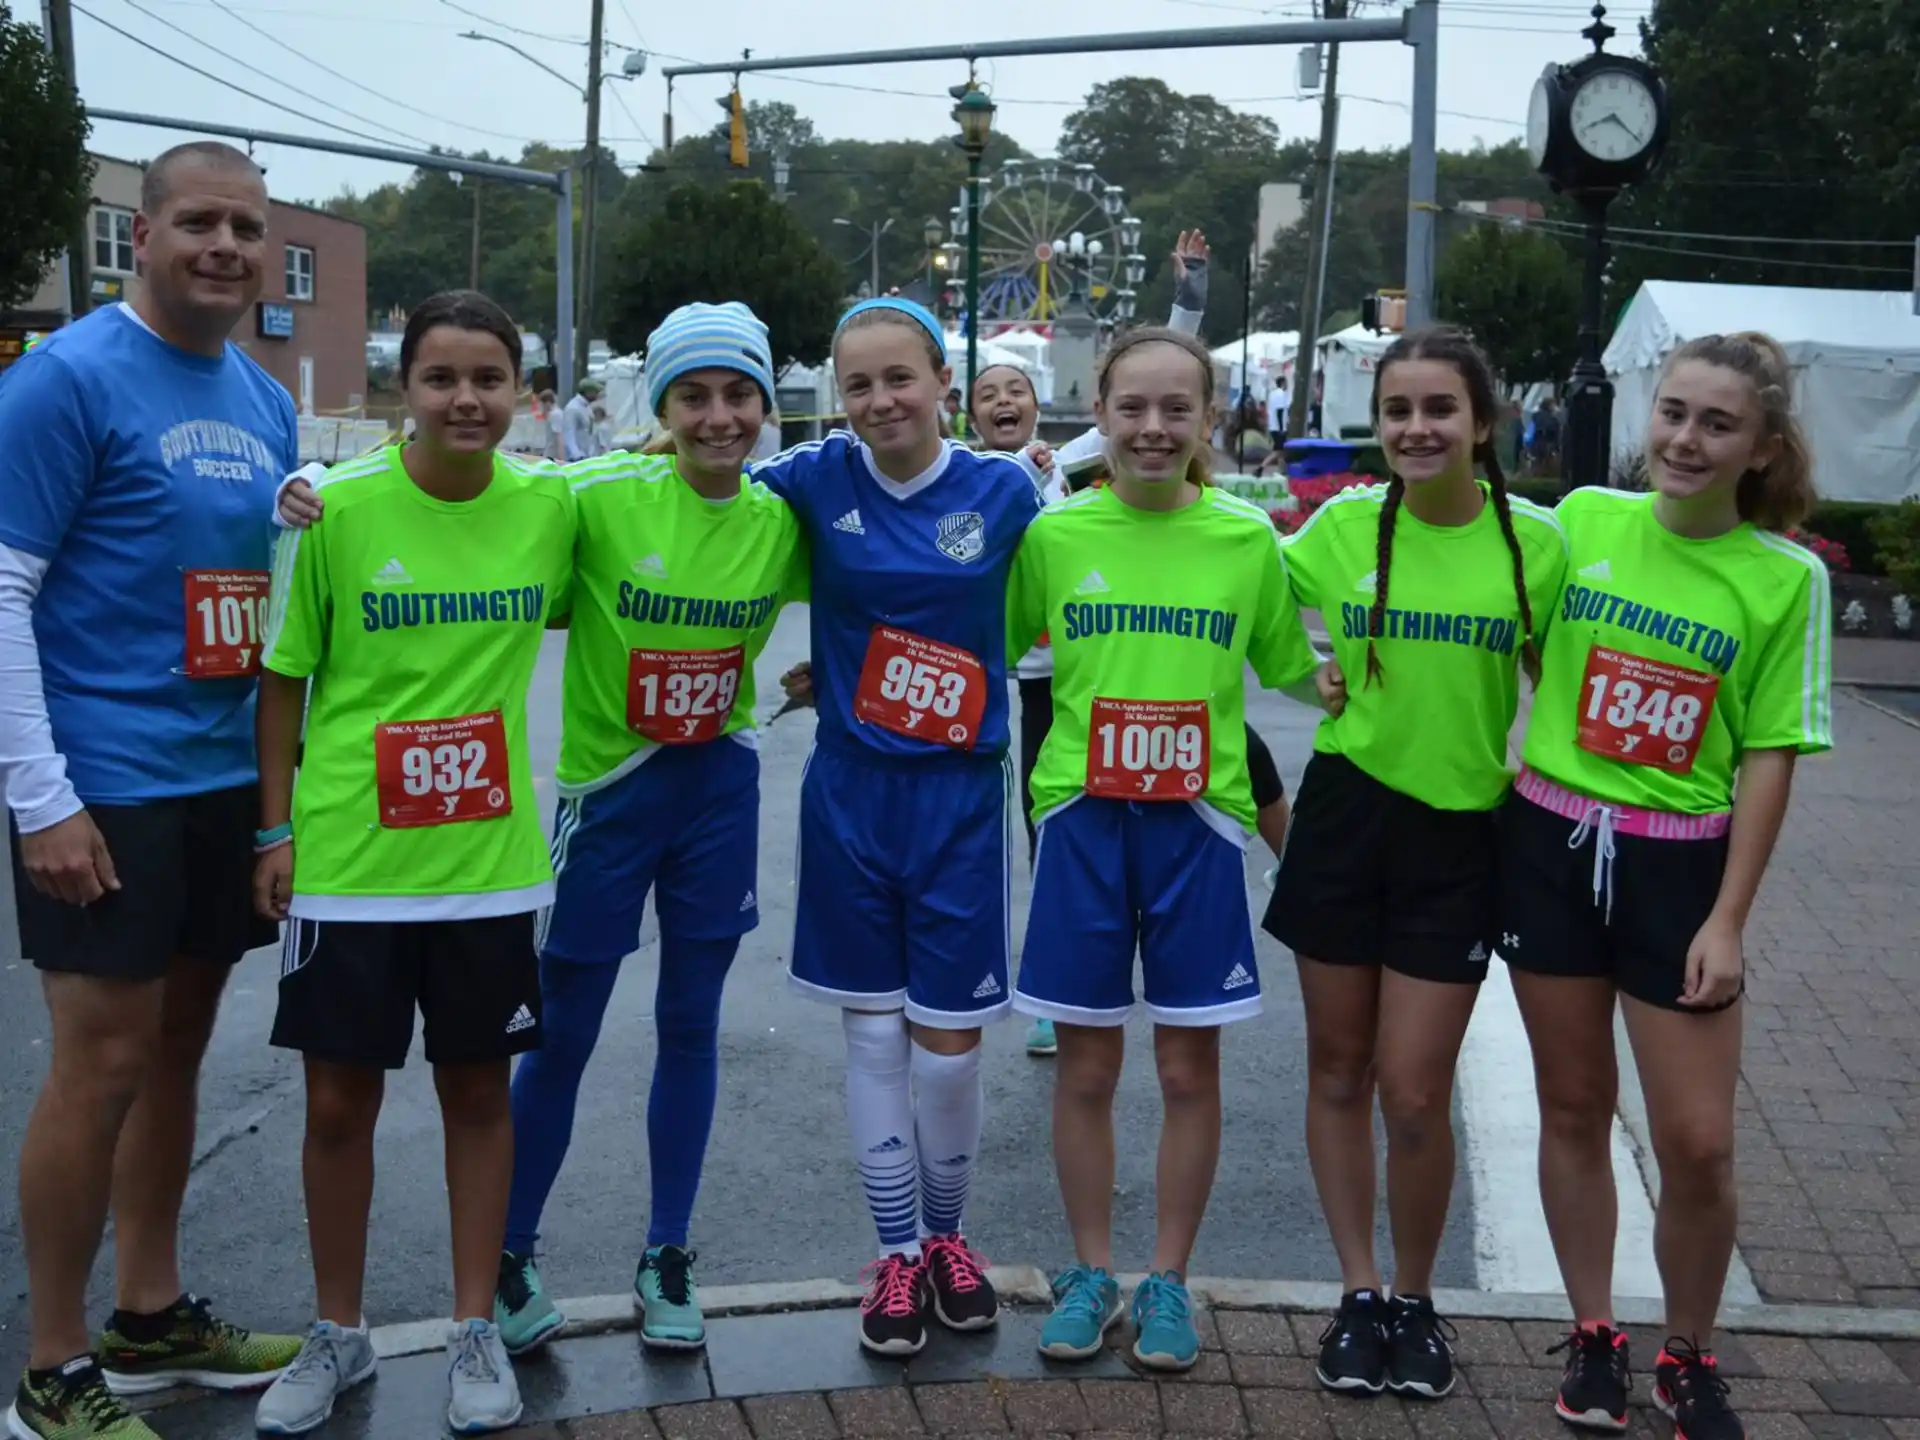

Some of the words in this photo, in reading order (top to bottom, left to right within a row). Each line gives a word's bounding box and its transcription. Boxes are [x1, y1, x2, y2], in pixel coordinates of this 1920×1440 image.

[192, 458, 253, 481] SOCCER
[360, 583, 545, 632] SOUTHINGTON
[616, 579, 778, 629] SOUTHINGTON
[1063, 602, 1238, 651] SOUTHINGTON
[1561, 583, 1741, 671] SOUTHINGTON
[639, 667, 738, 717] 1329
[880, 656, 967, 718] 953
[1586, 673, 1702, 743] 1348
[402, 740, 490, 796] 932
[1098, 723, 1202, 771] 1009
[1648, 811, 1730, 840] UNDE
[506, 1017, 536, 1033] adidas
